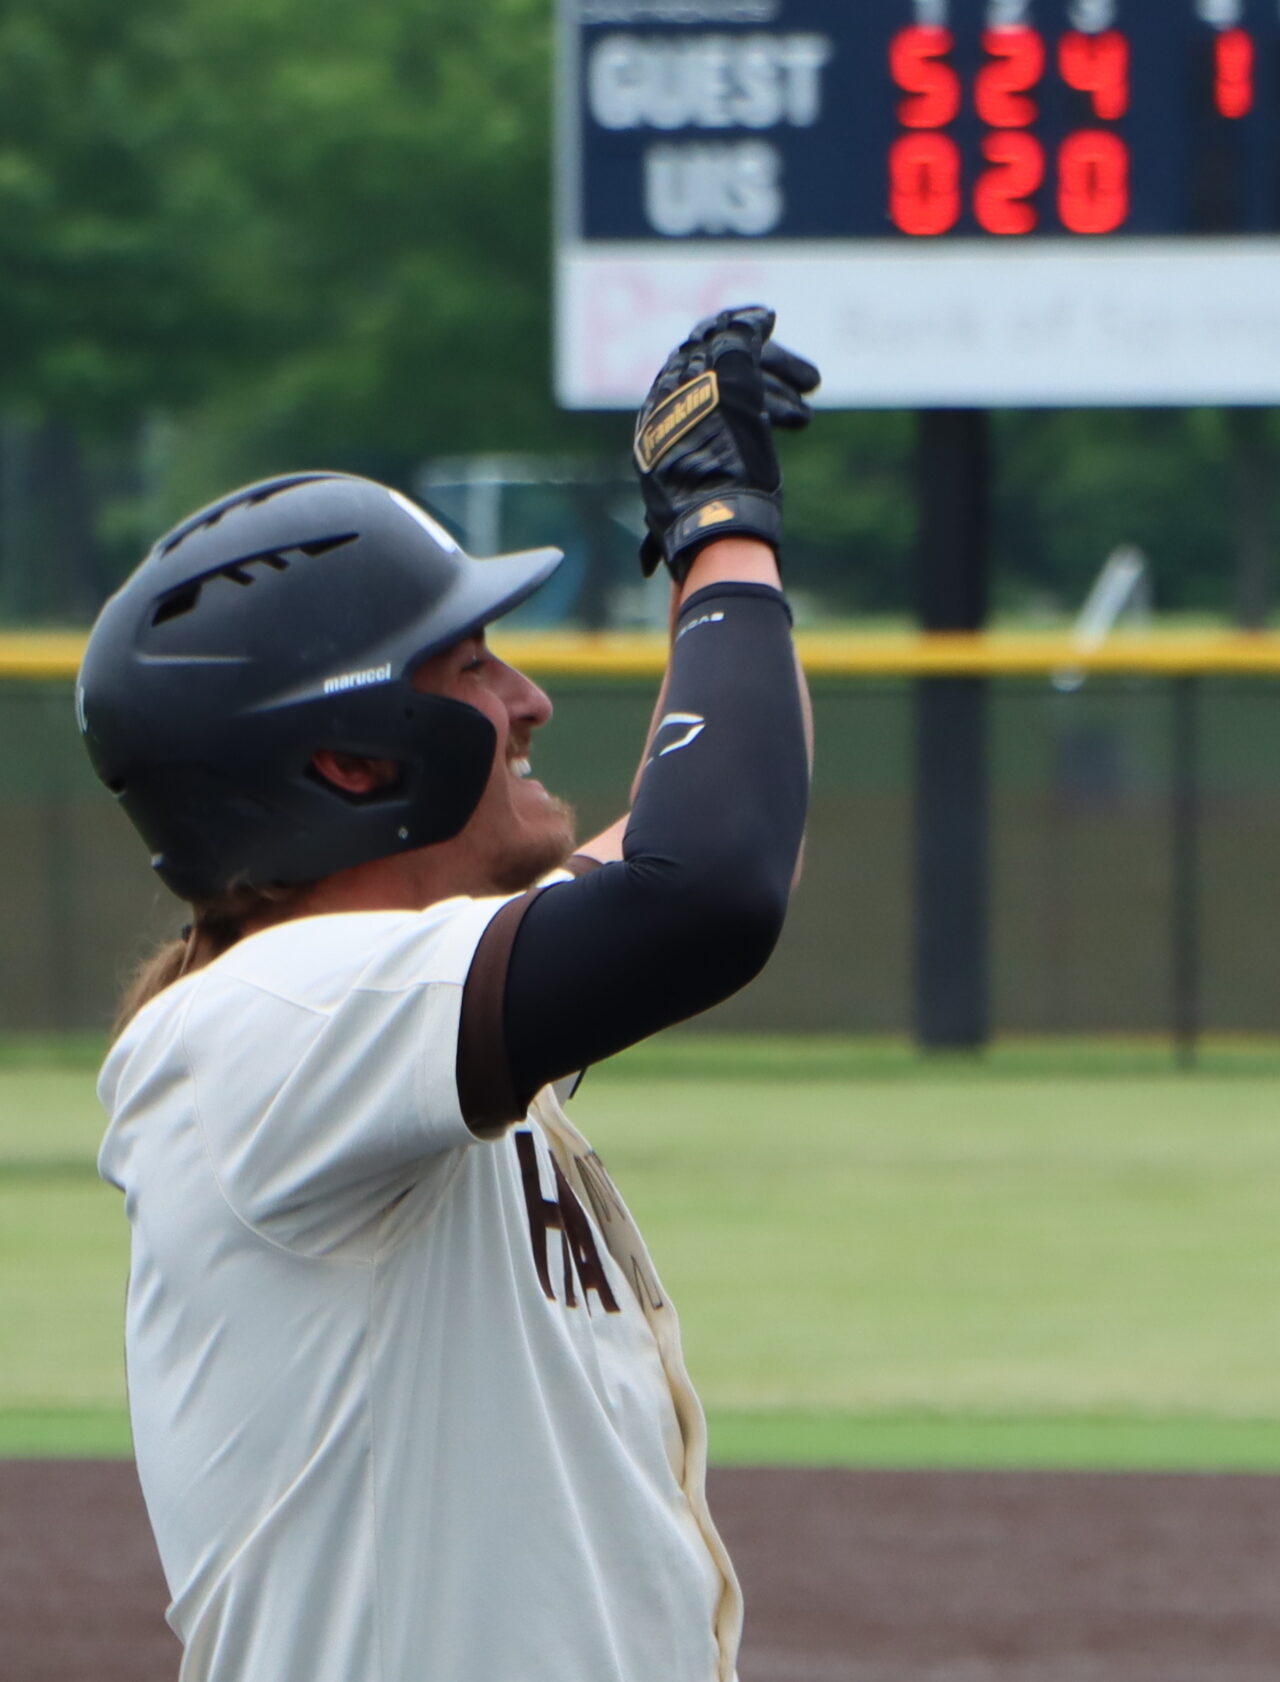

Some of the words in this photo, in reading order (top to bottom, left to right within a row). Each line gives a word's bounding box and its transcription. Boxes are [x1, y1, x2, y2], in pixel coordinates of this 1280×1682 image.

[589, 33, 830, 129] GUEST
[889, 24, 960, 128] 5
[974, 24, 1044, 128] 2
[1058, 29, 1129, 120] 4
[1215, 28, 1254, 118] 1
[889, 129, 960, 235] 0
[974, 129, 1043, 235] 2
[1057, 129, 1129, 234] 0
[643, 383, 712, 462] Franklin
[324, 662, 392, 694] marucci
